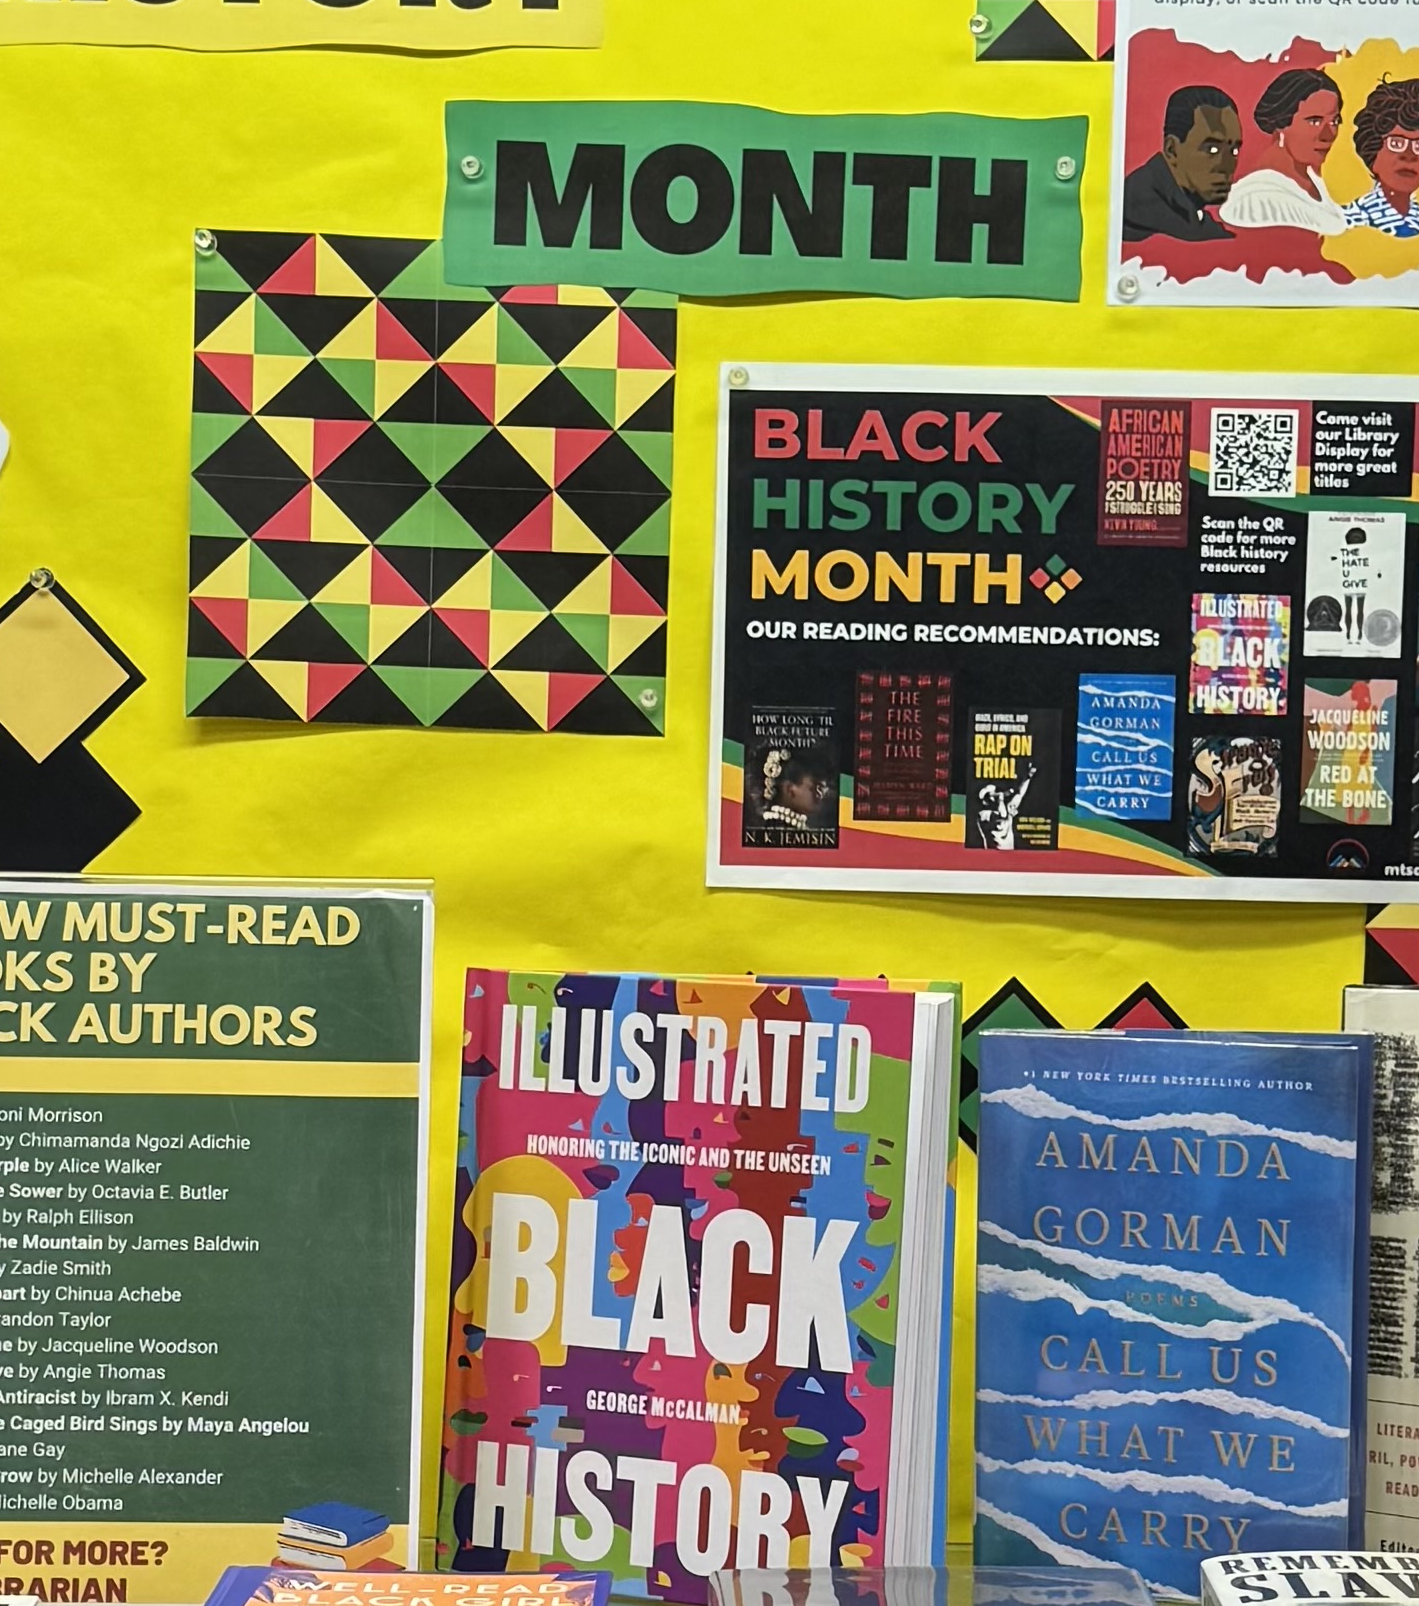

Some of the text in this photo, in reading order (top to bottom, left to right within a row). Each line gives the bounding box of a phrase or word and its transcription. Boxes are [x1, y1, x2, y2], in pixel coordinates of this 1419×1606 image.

[494, 140, 1027, 265] MONTH
[754, 409, 1002, 463] BLACK
[1315, 427, 1399, 448] our Library
[1316, 410, 1392, 426] Come visit
[1314, 461, 1397, 477] more great
[1315, 442, 1396, 464] Display for
[1314, 474, 1350, 489] titles
[753, 478, 1075, 534] HISTORY
[1202, 515, 1284, 534] Scan the QR
[1201, 531, 1296, 547] code for more
[1201, 545, 1289, 562] Black history
[751, 549, 1022, 604] MONTH
[1200, 561, 1266, 574] resources
[746, 621, 1160, 646] OUR READING RECOMMENDATIONS:
[62, 901, 360, 945] MUST-READ
[89, 952, 157, 993] BY
[68, 1003, 317, 1047] AUTHORS
[499, 1004, 871, 1113] ILLUSTRATED
[28, 1107, 102, 1122] Morrison
[34, 1158, 54, 1176] by
[58, 1158, 100, 1173] Alice
[105, 1159, 162, 1174] Walker
[1036, 1131, 1290, 1179] AMANDA
[1031, 1206, 1290, 1255] GORMAN
[486, 1194, 859, 1373] BLACK
[1042, 1336, 1276, 1386] CALL US
[1027, 1416, 1294, 1471] WHAT WE
[472, 1439, 850, 1581] HISTORY
[1062, 1504, 1255, 1556] CARRY
[63, 1540, 169, 1566] MORE?
